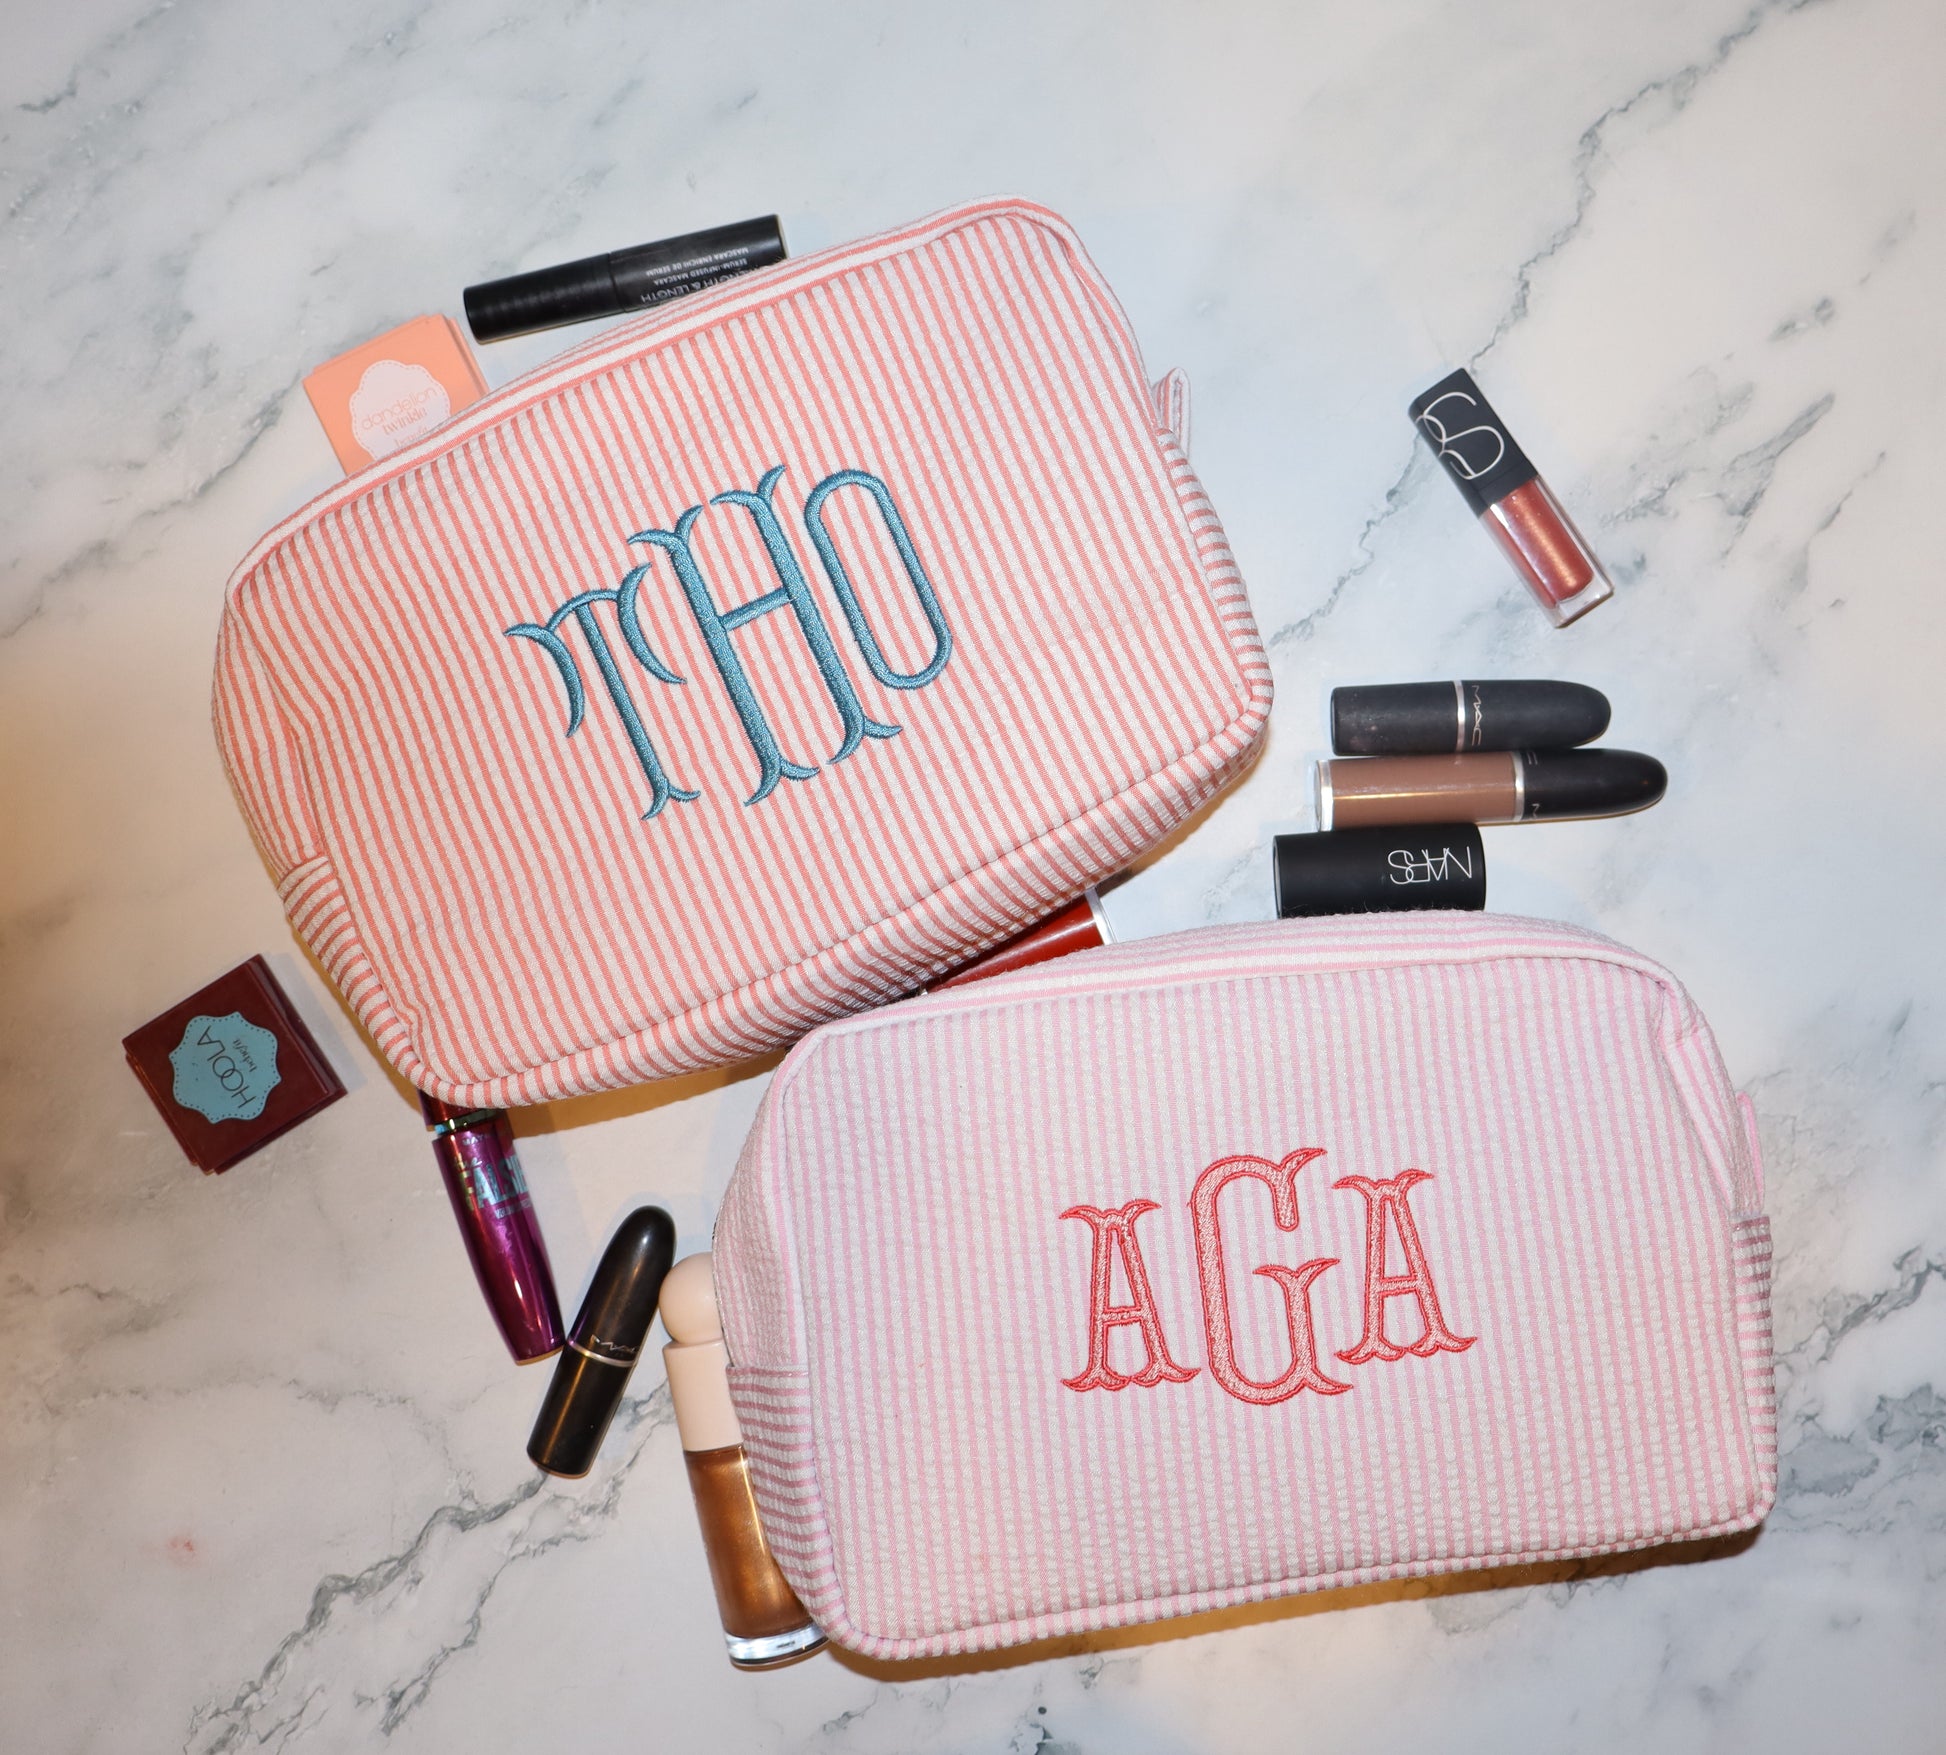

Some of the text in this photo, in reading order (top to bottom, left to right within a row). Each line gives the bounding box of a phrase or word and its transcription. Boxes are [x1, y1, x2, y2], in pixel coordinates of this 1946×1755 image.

[672, 262, 683, 270] DE
[714, 247, 749, 261] MASCARA
[640, 284, 690, 303] LENGTH
[654, 272, 689, 286] MASCARA
[361, 387, 438, 431] dandelion
[382, 407, 428, 435] twinkle
[502, 464, 954, 821] THO
[1387, 845, 1473, 885] NARS
[197, 1025, 257, 1109] HOOLA
[232, 1037, 258, 1073] benefit
[1058, 1147, 1479, 1406] AGA
